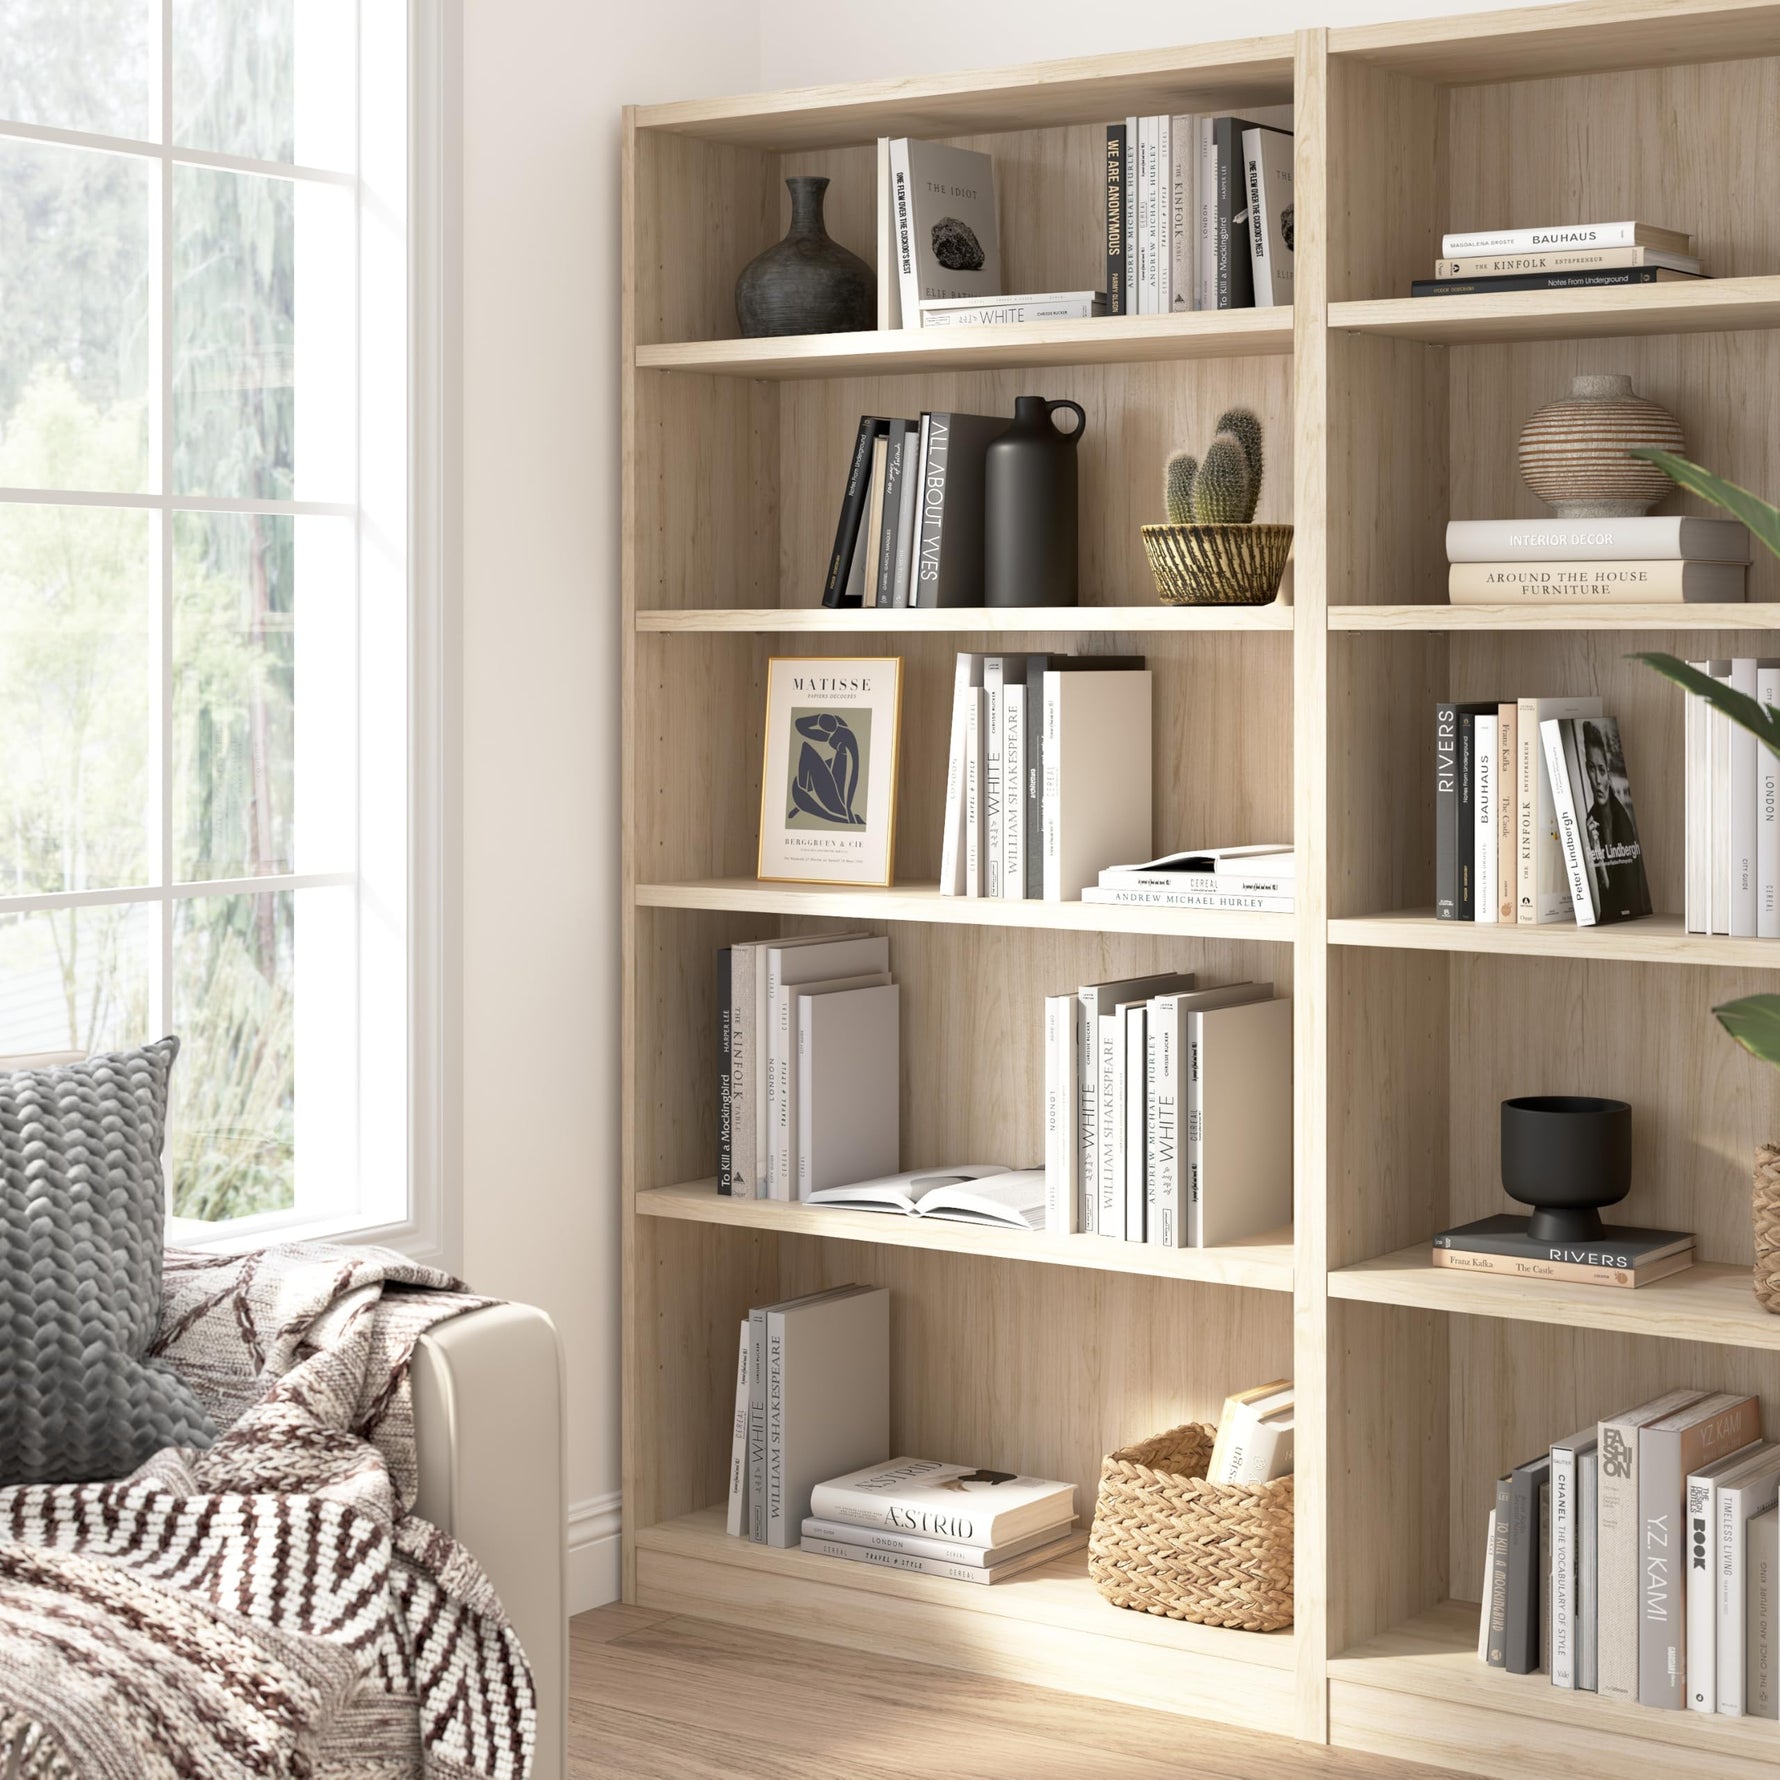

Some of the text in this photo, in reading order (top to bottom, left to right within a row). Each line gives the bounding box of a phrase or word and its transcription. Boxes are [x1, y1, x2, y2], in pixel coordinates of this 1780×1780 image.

[1276, 170, 1292, 182] THE
[927, 182, 978, 200] THE IDIOT
[1108, 140, 1120, 256] WE ARE ANONYMOUS
[1251, 189, 1260, 204] OVER
[1174, 182, 1184, 239] KINFOLK
[1252, 204, 1260, 215] THE
[898, 202, 907, 218] OVER
[903, 259, 911, 274] NEST
[1219, 217, 1229, 271] Mockingbird
[1450, 240, 1489, 249] MAGDALENA
[1532, 231, 1597, 245] BAUHAUS
[1255, 243, 1263, 258] NEST
[1493, 258, 1547, 271] KINFOLK
[1219, 281, 1227, 294] Kill
[1547, 275, 1629, 287] Notes From Underground
[926, 288, 948, 298] ELIF
[1219, 296, 1228, 307] To
[979, 308, 1025, 324] WHITE
[849, 434, 866, 497] Notes Underground
[920, 420, 949, 581] ALL ABOUT YVES
[1509, 533, 1614, 547] INTERIOR DECOR
[1486, 571, 1648, 583] AROUND THE HOUSE
[1522, 584, 1611, 595] FURNITURE
[792, 678, 872, 692] MATISSE
[1438, 710, 1454, 793] RIVERS
[1502, 724, 1510, 773] Franz Kafka
[987, 752, 1001, 817] WHITE
[1008, 705, 1018, 874] WILLIAM SHAKESPEARE
[1480, 755, 1489, 824] BAUHAUS
[1765, 775, 1775, 822] LONDON
[1502, 796, 1510, 839] The Castle
[1522, 801, 1531, 859] KINFOLK
[784, 838, 864, 849] BERGGRUEN CIE
[1605, 841, 1641, 859] Lindbergh
[1561, 811, 1584, 901] Peter Lindbergh
[1190, 878, 1218, 889] CEREAL
[1115, 893, 1265, 908] ANDREW MICHAEL HURLEY
[733, 1031, 743, 1100] KINFOLK
[721, 1074, 732, 1142] Mockingbird
[1081, 1084, 1095, 1149] WHITE
[1104, 1038, 1114, 1209] WILLIAM SHAKESPEARE
[1148, 1034, 1156, 1204] ANDREW MICHAEL HURLEY
[1159, 1095, 1175, 1163] WHITE
[721, 1154, 730, 1170] Kill
[721, 1173, 731, 1186] To
[1450, 1255, 1494, 1268] Franz Kafka
[1550, 1249, 1628, 1268] RIVERS
[1515, 1263, 1555, 1275] The Castle
[736, 1410, 744, 1439] CEREAL
[751, 1401, 764, 1463] WHITE
[771, 1335, 781, 1519] WILLIAM SHAKESPEARE
[1716, 1410, 1742, 1440] KAMI
[1603, 1427, 1625, 1447] FA
[1603, 1443, 1633, 1464] SHI
[1603, 1460, 1631, 1480] ON
[1702, 1488, 1710, 1502] THE
[871, 1537, 904, 1549] LONDON
[1693, 1518, 1706, 1571] BOOK
[1723, 1497, 1733, 1577] TIMELESS LIVING
[823, 1546, 848, 1557] CEREAL
[865, 1552, 923, 1570] TRAVEL STYLE
[949, 1568, 975, 1580] CEREAL
[1558, 1474, 1566, 1656] CHANEL THE VOCABULARY OF STYLE
[1647, 1514, 1668, 1622] Y.Z. KAMI
[1492, 1521, 1509, 1632] TO KILL A MOCKINGBIRD
[1759, 1560, 1768, 1688] THE ONCE AND FUTURE KING
